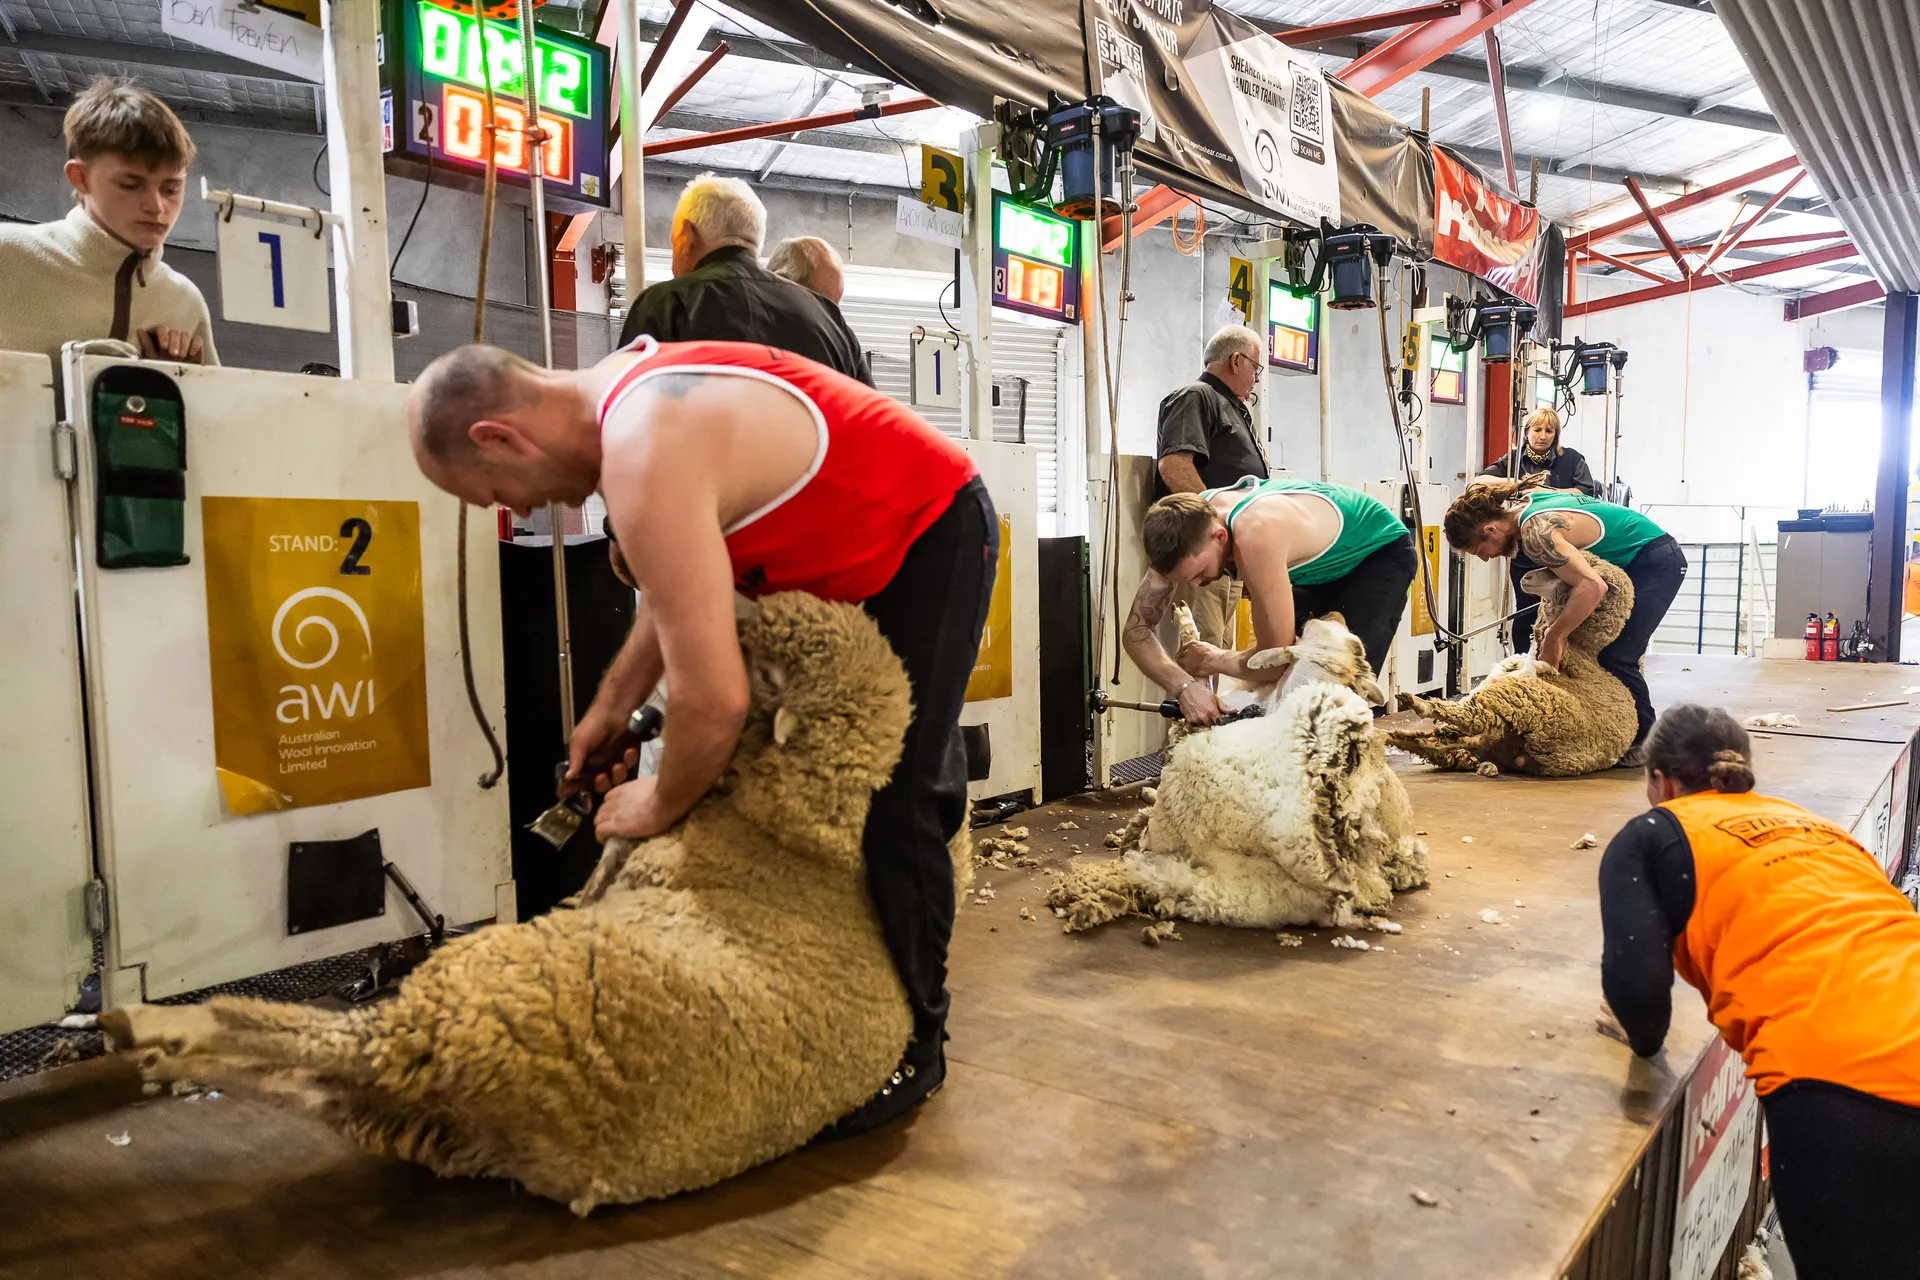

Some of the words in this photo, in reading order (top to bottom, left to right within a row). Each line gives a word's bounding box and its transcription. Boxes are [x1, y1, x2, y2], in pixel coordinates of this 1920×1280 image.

[1095, 0, 1129, 25] EAR
[1144, 0, 1183, 27] ORTS
[1098, 23, 1141, 62] SPORTS
[1100, 39, 1143, 80] SHEAR
[417, 105, 434, 142] 2
[1300, 144, 1313, 158] SCAN
[931, 153, 960, 213] 3
[258, 231, 285, 308] 1
[996, 269, 1004, 293] 3
[1231, 264, 1251, 315] 4
[1406, 326, 1419, 367] 5
[933, 349, 942, 396] 1
[269, 535, 339, 552] STAND:
[340, 517, 372, 576] 2
[1428, 532, 1434, 553] 5
[279, 730, 340, 745] Australian
[279, 745, 312, 759] Wool
[314, 740, 377, 755] Innovation
[279, 757, 327, 774] Limited
[1687, 1040, 1749, 1170] Heinig
[1680, 1197, 1705, 1271] THE
